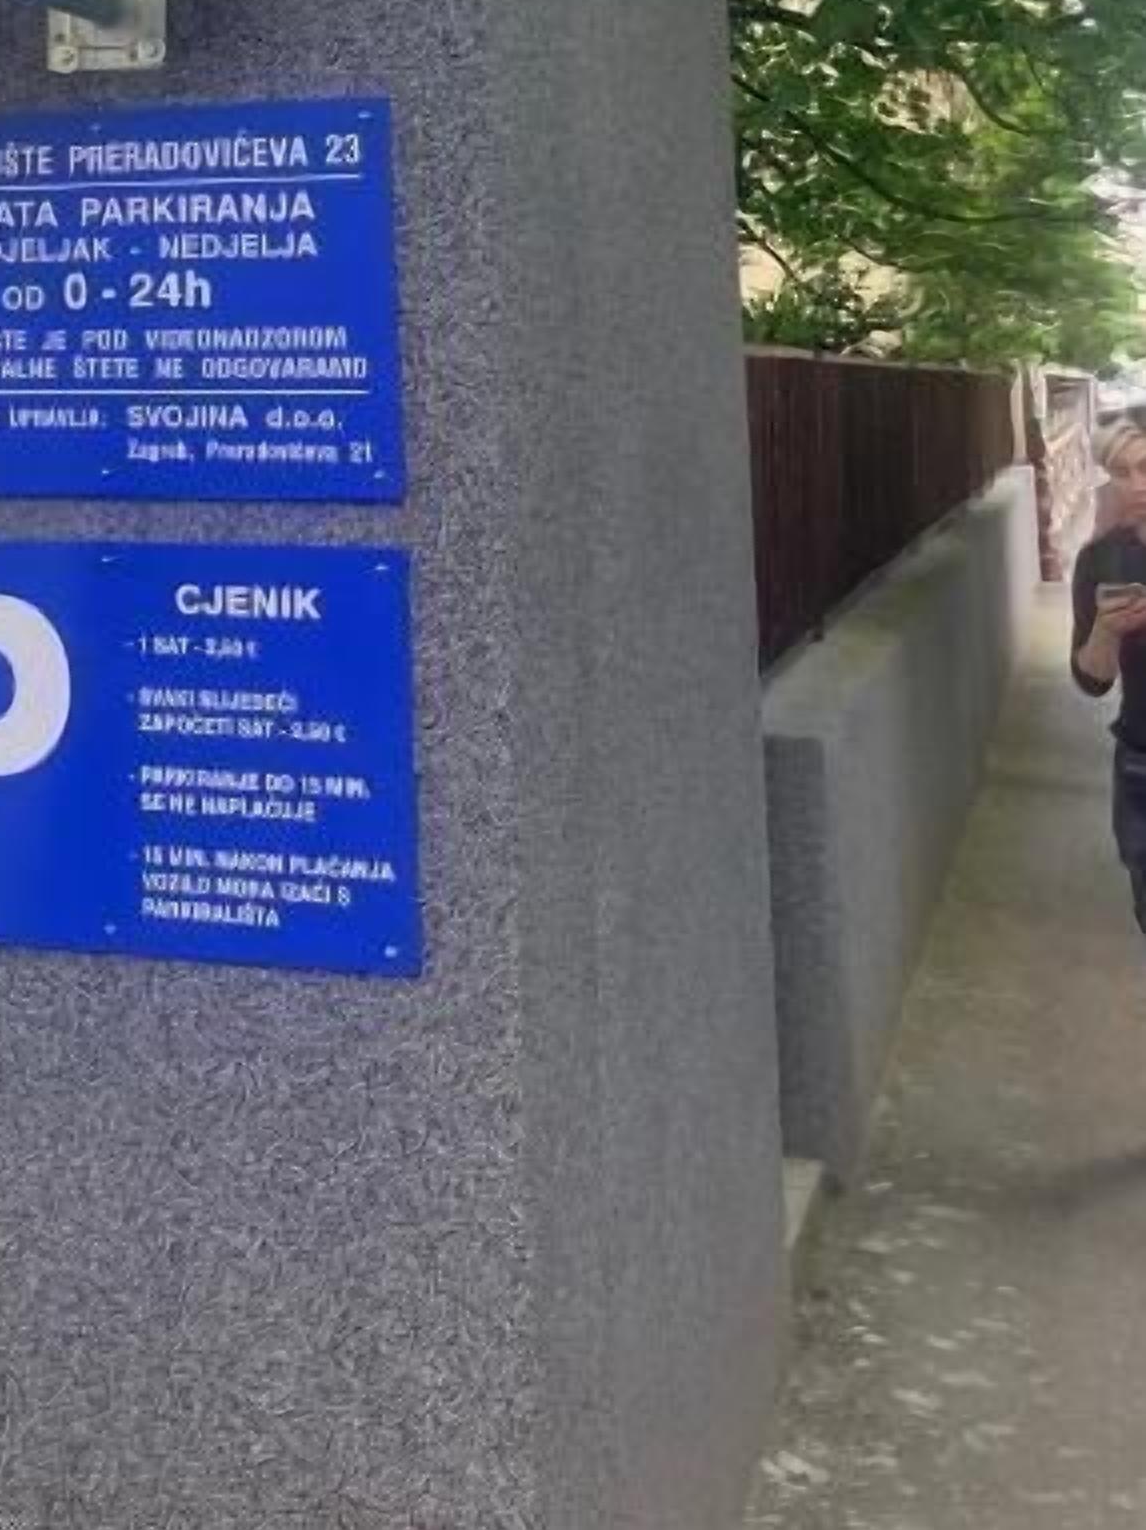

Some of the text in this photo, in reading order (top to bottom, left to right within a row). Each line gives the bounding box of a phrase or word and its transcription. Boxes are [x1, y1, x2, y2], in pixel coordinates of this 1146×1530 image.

[325, 133, 361, 164] 23
[80, 189, 316, 227] PARKIRANJA
[159, 231, 318, 261] NEDJELJA
[2, 285, 45, 311] OD
[63, 271, 87, 310] 0
[129, 268, 211, 308] 24h
[126, 404, 249, 430] SVOJINA
[175, 583, 321, 620] CJENIK
